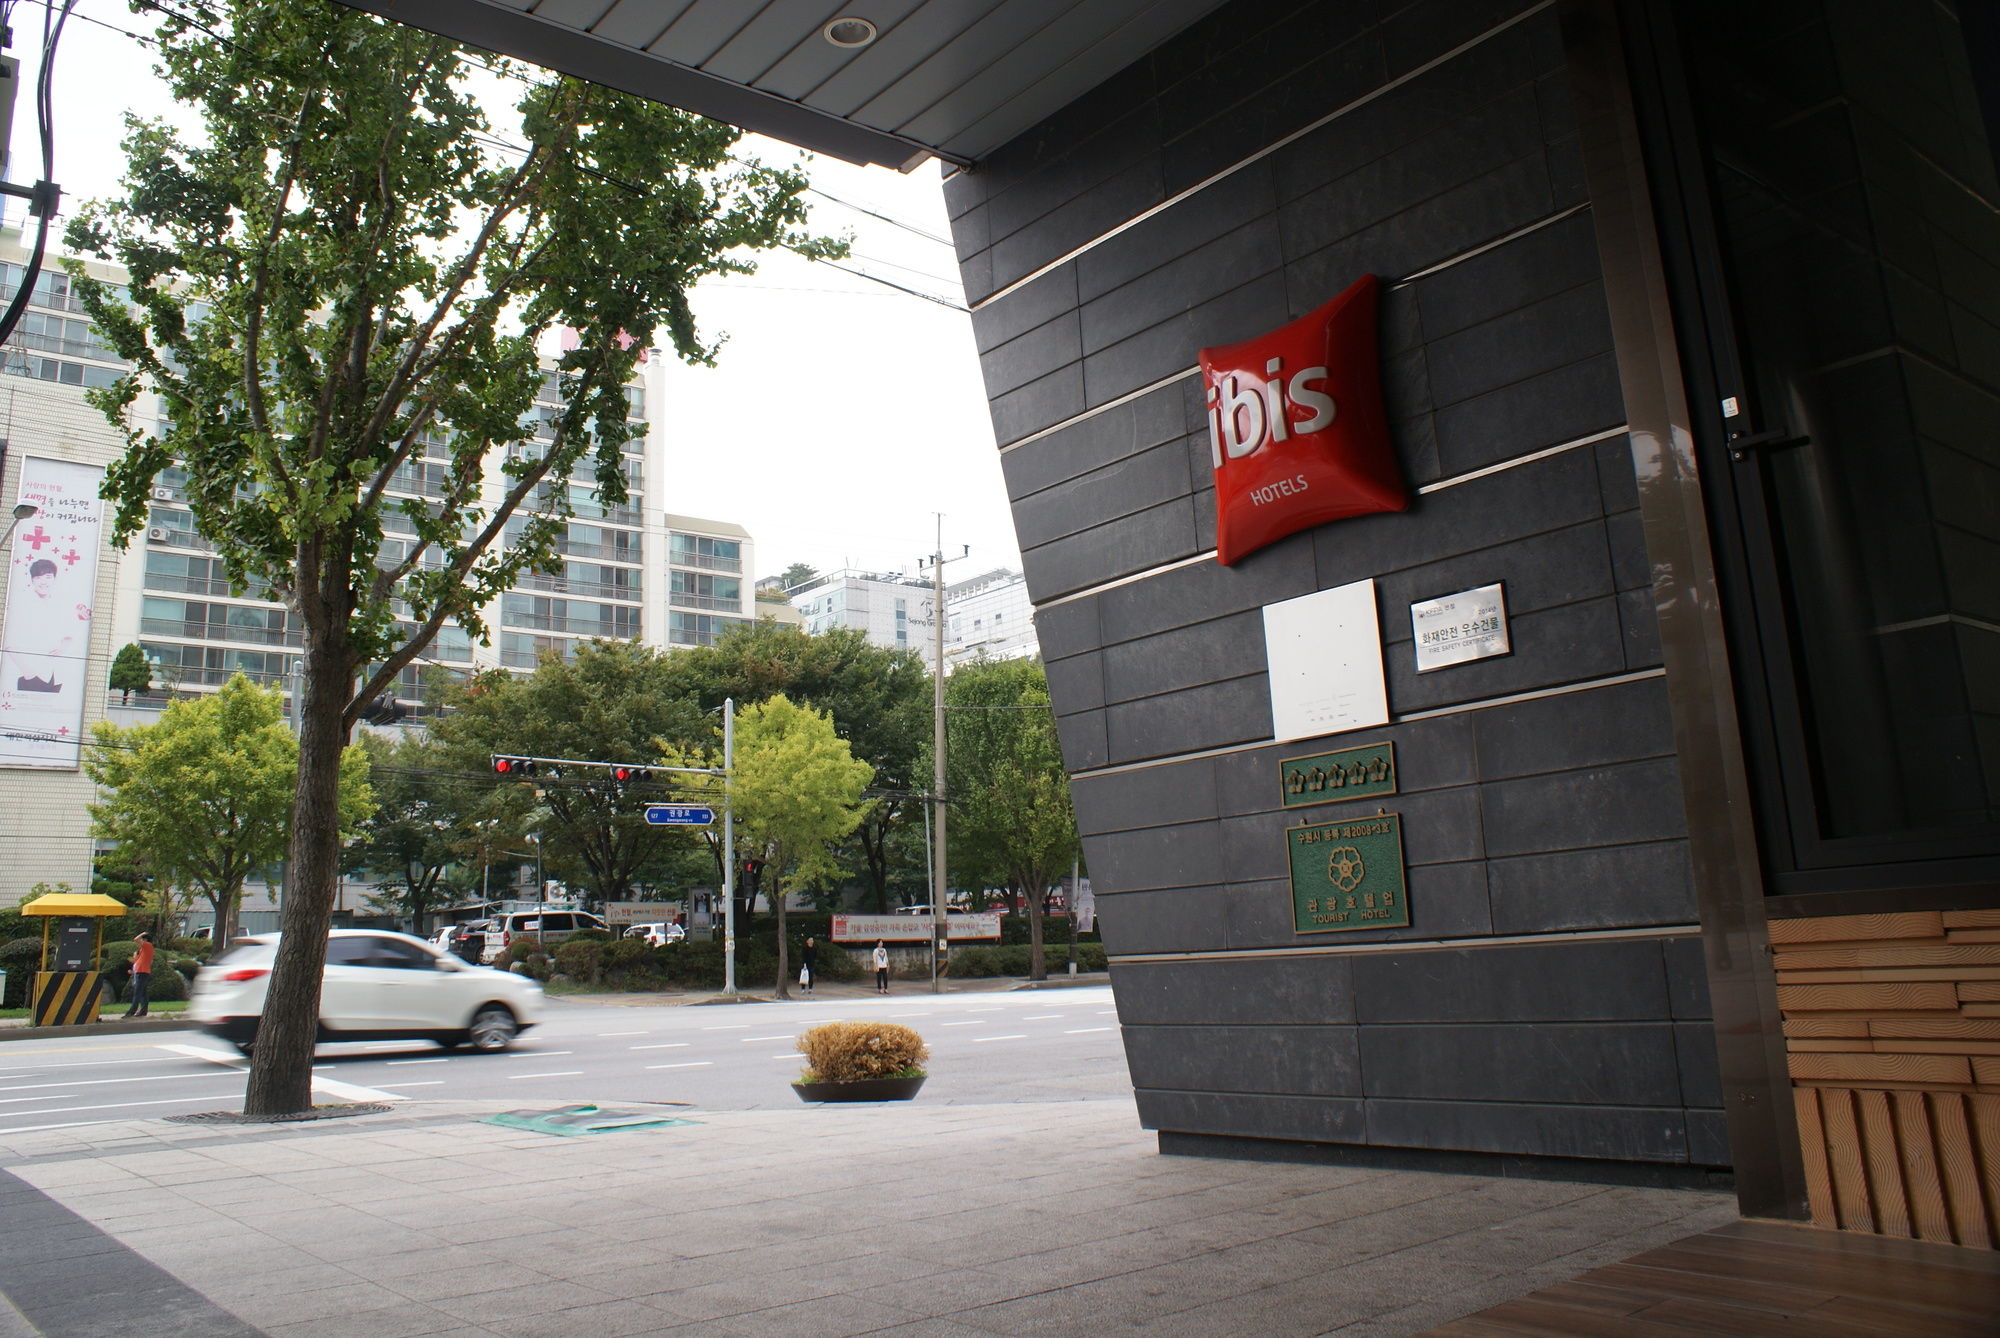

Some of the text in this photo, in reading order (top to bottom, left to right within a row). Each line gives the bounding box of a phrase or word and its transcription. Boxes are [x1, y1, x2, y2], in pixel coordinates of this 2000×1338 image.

[1207, 357, 1336, 469] ibis
[1250, 474, 1308, 506] HOTELS
[1422, 617, 1499, 644] 화재안전 우수건물
[1441, 642, 1461, 652] SAFETY
[1312, 909, 1391, 923] TOURIST HOTEL
